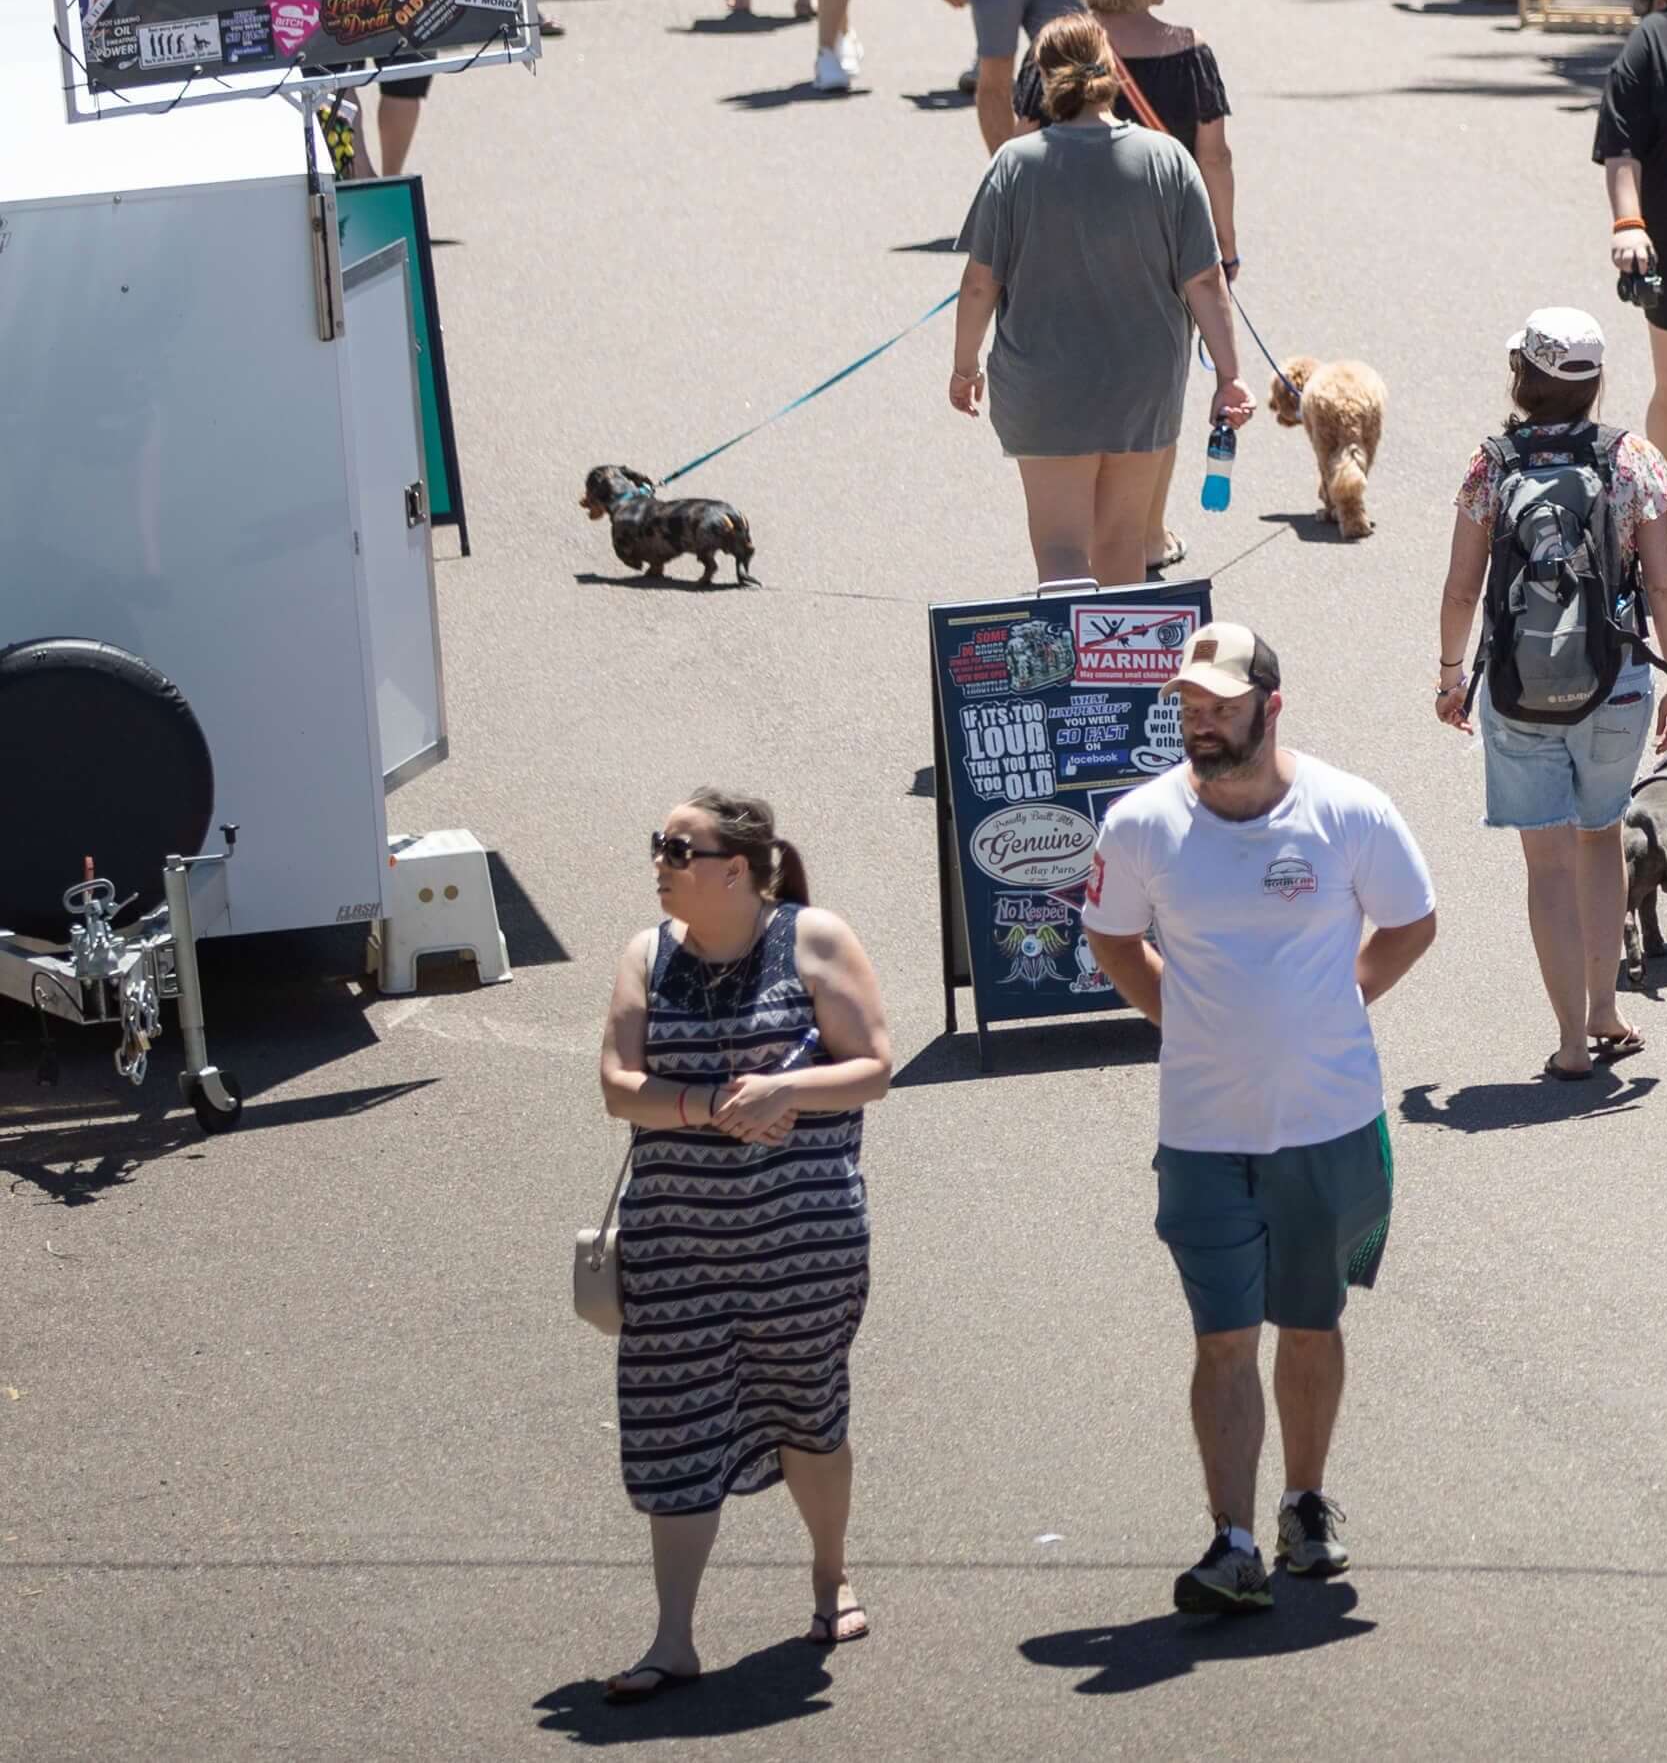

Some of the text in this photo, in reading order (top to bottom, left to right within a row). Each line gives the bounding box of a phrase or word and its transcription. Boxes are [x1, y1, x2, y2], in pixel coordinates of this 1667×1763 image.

[114, 26, 131, 37] OIL
[975, 628, 1008, 643] SOME
[1070, 693, 1110, 706] WHAT
[963, 709, 978, 729] IF
[1012, 703, 1043, 723] TOO
[1064, 714, 1118, 727] YOU WERE
[1153, 708, 1174, 720] not
[1056, 724, 1129, 745] SO FAST
[1150, 722, 1176, 735] well
[968, 721, 1046, 760] LOUD
[1085, 742, 1101, 751] ON
[1156, 737, 1183, 749] othe
[969, 753, 1052, 777] THEN YOU ARE
[1070, 752, 1119, 765] facebook
[974, 769, 1053, 800] TOO OLD
[979, 828, 1083, 865] Genuine
[1024, 864, 1077, 876] eBay Parts
[994, 897, 1070, 922] No Respect
